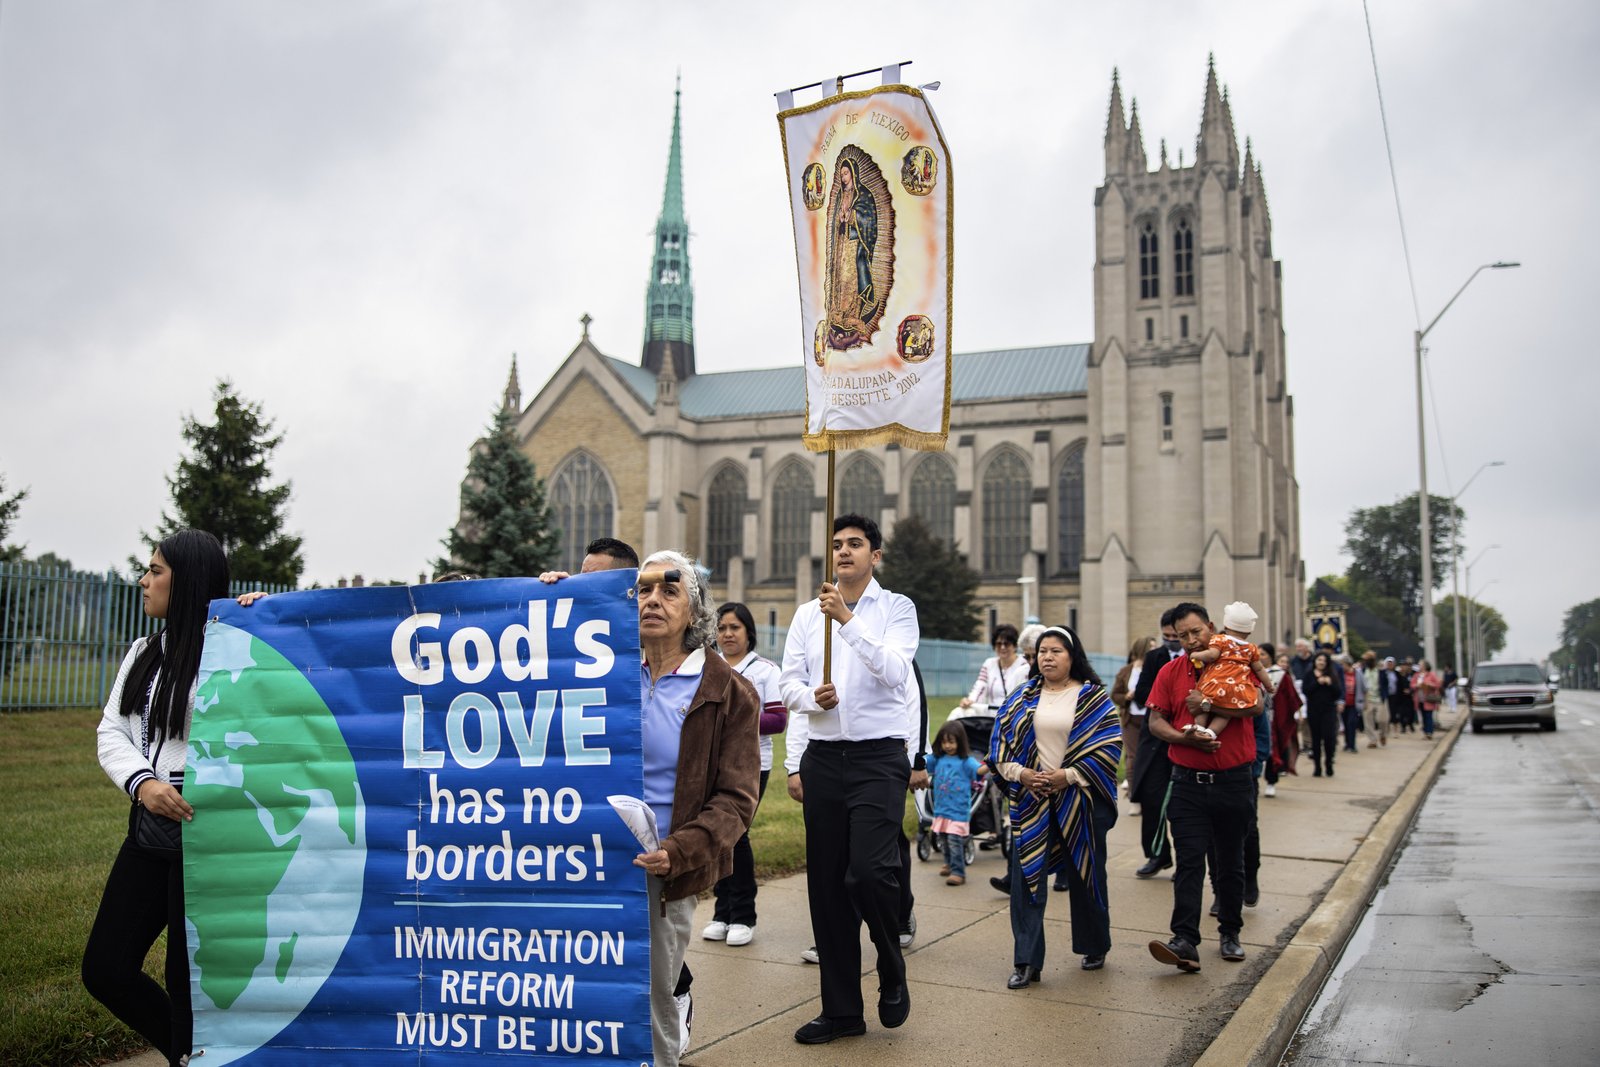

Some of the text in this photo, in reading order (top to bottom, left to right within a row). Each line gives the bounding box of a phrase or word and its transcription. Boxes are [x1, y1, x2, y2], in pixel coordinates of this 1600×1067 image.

[845, 113, 859, 125] DE
[822, 370, 897, 390] ADALUPANA
[831, 387, 891, 407] BESSETTE
[896, 372, 921, 395] 2012
[391, 597, 615, 686] God's
[402, 687, 612, 769] LOVE
[429, 773, 583, 824] has no
[406, 829, 606, 882] borders!
[394, 926, 625, 966] IMMIGRATION
[440, 969, 575, 1009] REFORM
[395, 1012, 625, 1056] MUST BE JUST
